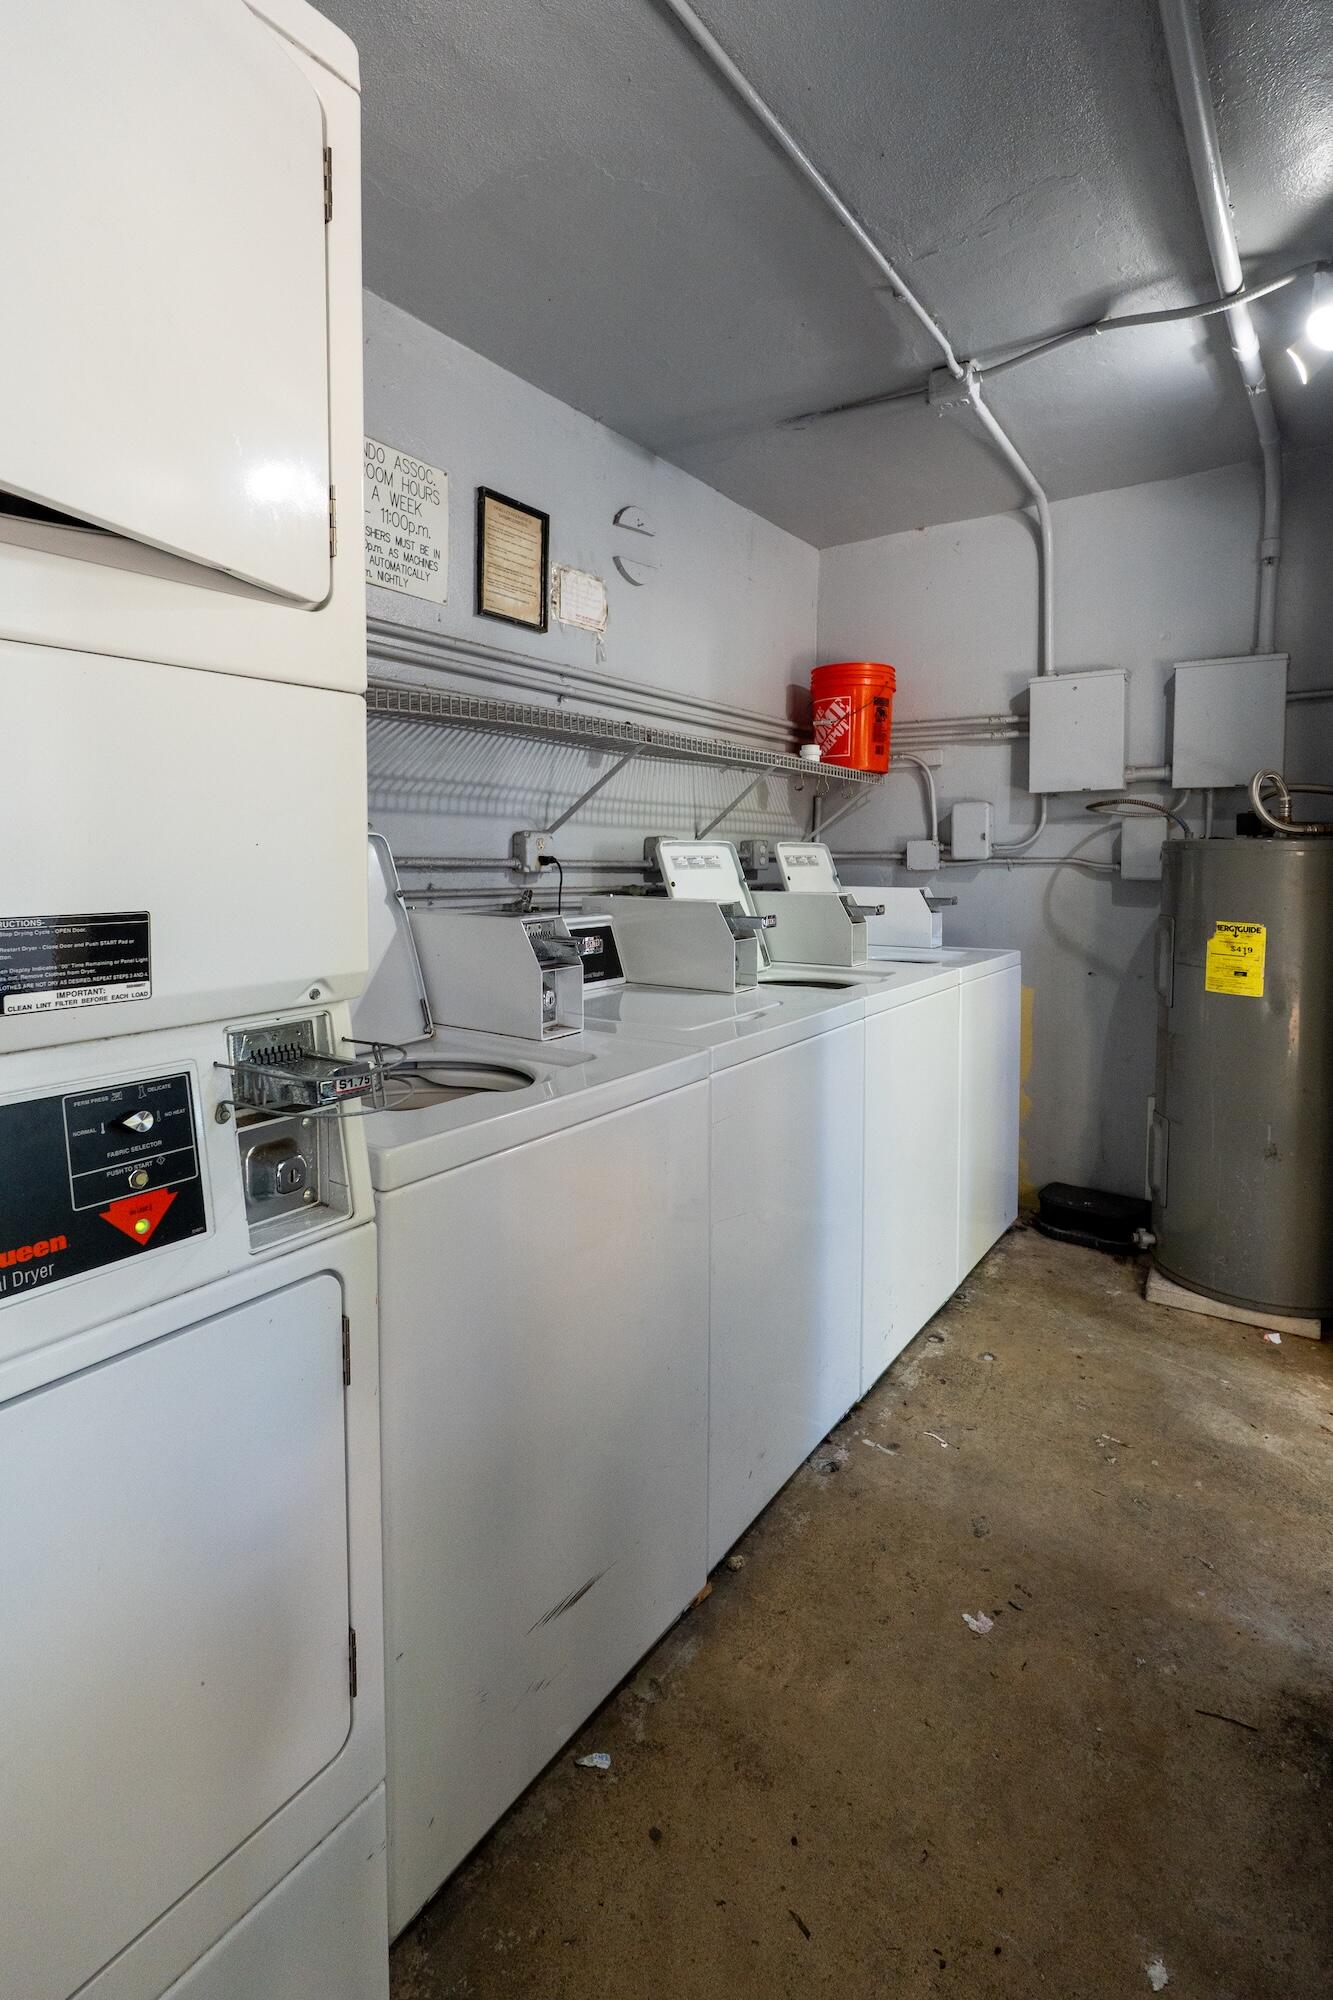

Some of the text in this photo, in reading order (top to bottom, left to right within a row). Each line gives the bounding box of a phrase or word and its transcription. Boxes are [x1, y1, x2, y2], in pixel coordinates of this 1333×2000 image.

[394, 455, 436, 487] ASSOC.
[364, 462, 440, 506] OOM HOURS
[371, 485, 423, 518] A WEEK
[380, 507, 431, 540] 11:00p.m.
[365, 525, 441, 561] SHERS MUST BE IN
[369, 554, 431, 582] AUTOMATICALLY
[388, 547, 399, 559] AS
[403, 551, 439, 572] MACHINES
[377, 570, 408, 588] NIGHTLY
[8, 990, 148, 1013] CLEAN LINT FILTER BEFORE EACH LOAD
[56, 987, 106, 999] IMPORTANT:
[147, 1083, 171, 1093] DELICATE
[73, 1095, 109, 1107] PERM PRESS
[72, 1128, 97, 1137] NORMAL
[106, 1140, 163, 1158] FABRIC SELECTOR
[106, 1161, 153, 1178] PUSH TO START
[12, 1263, 54, 1287] Dryer
